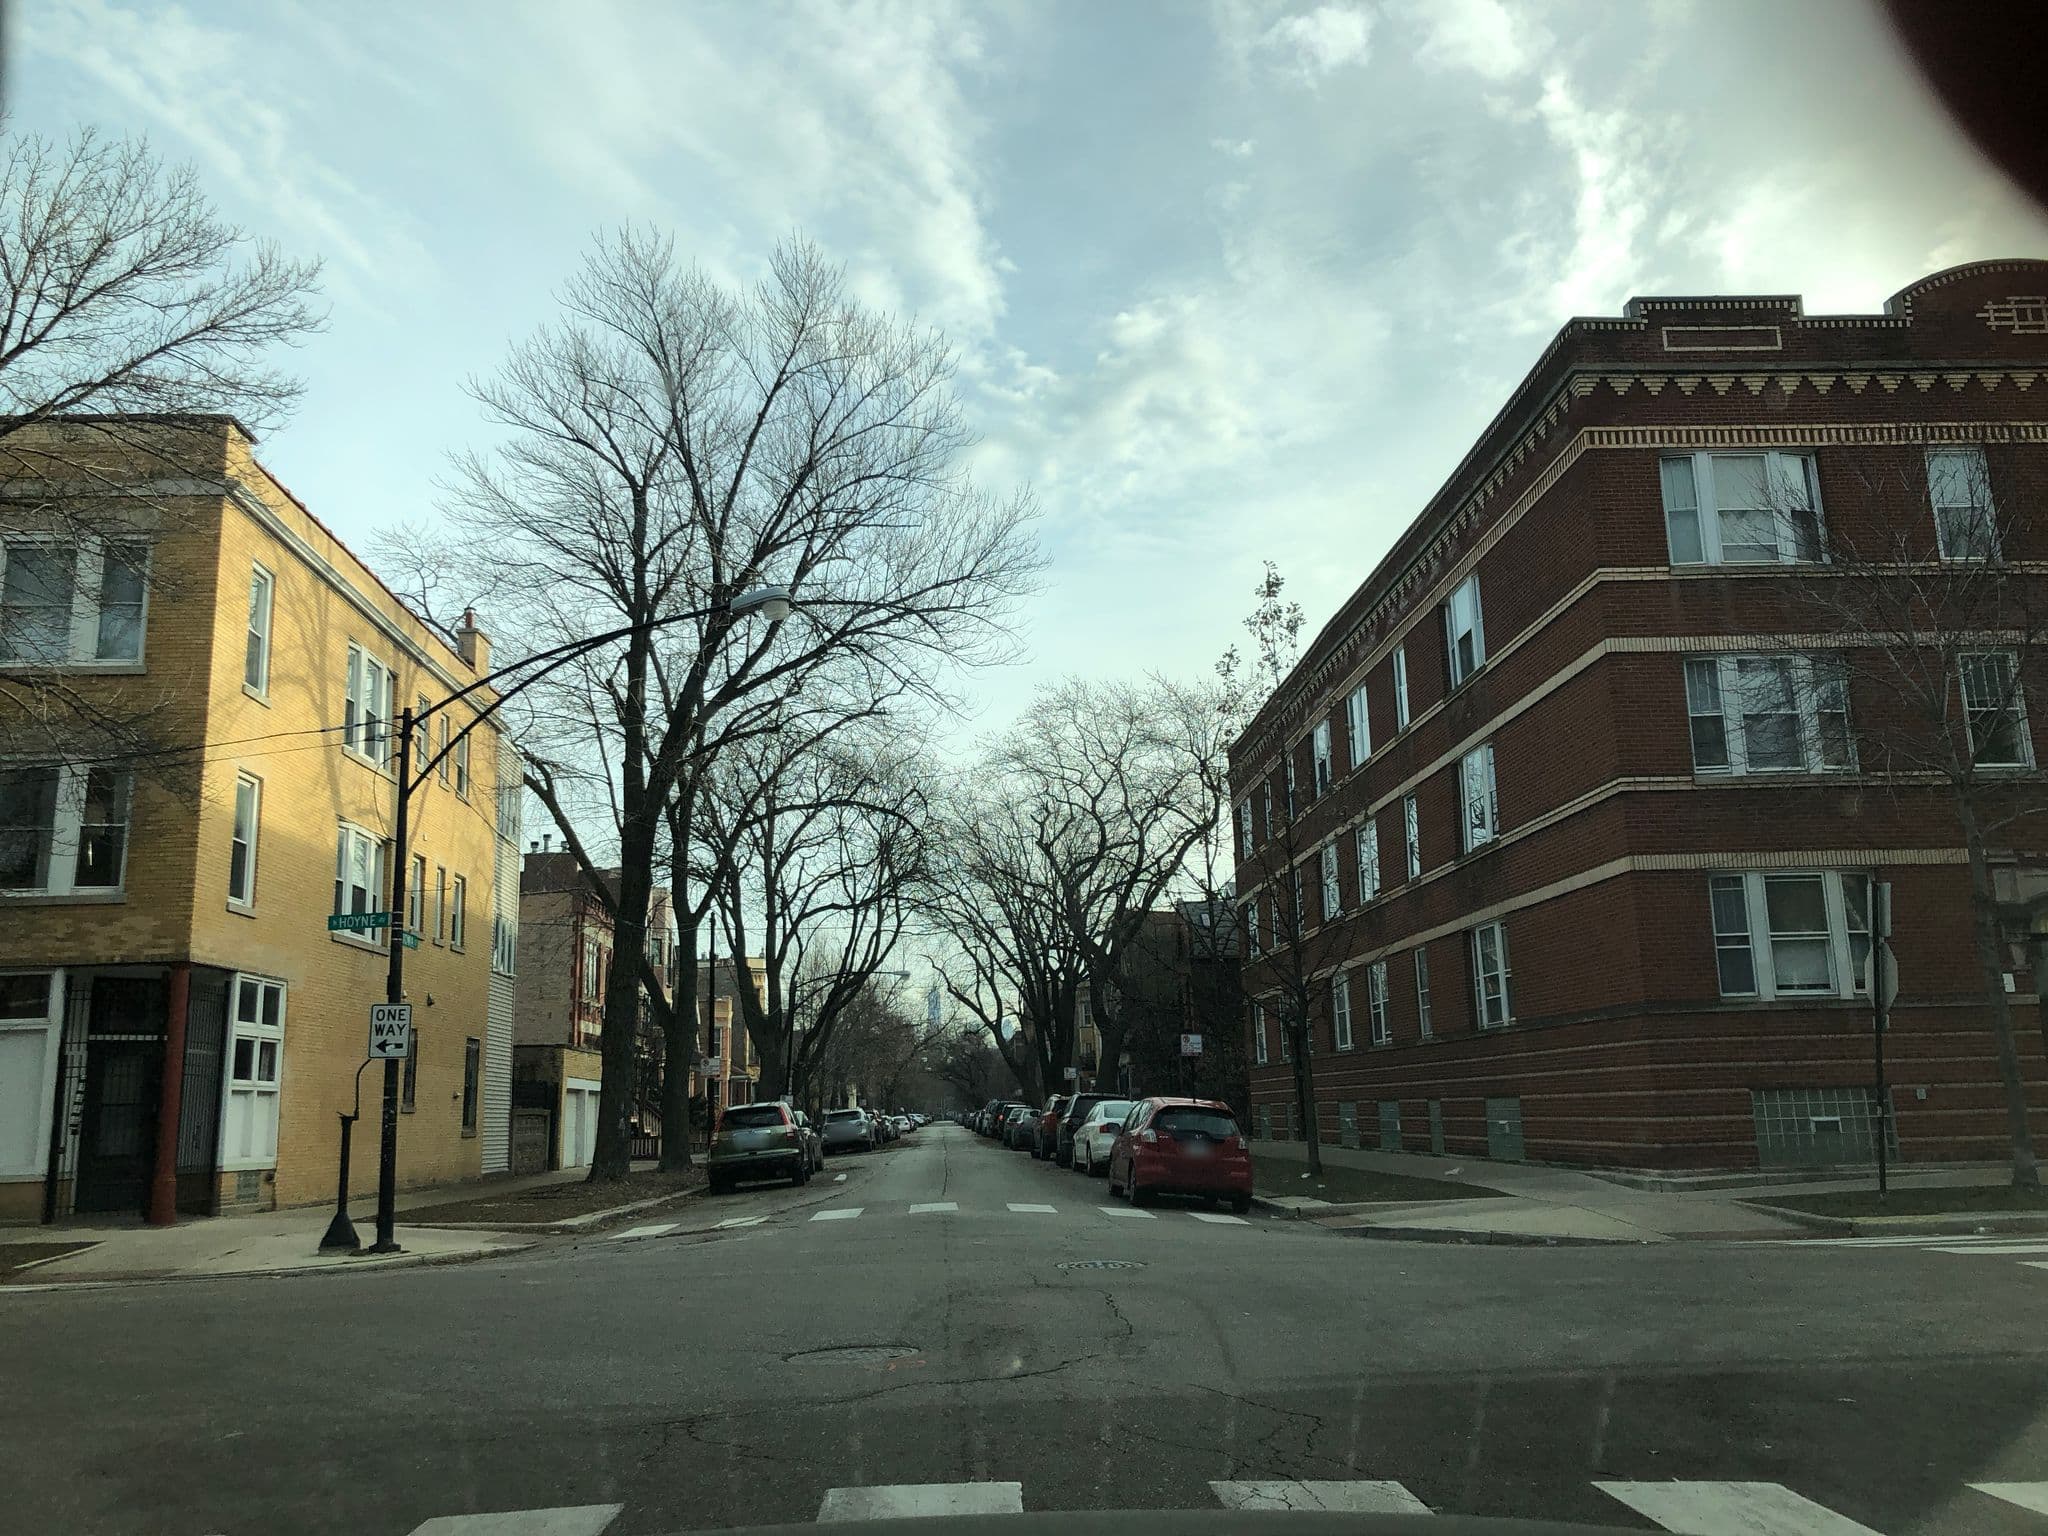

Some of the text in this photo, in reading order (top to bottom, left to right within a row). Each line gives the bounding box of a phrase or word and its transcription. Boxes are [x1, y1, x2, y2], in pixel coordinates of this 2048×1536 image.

[339, 914, 376, 928] HOYNE
[375, 1008, 407, 1021] ONE
[375, 1023, 407, 1036] WAY
